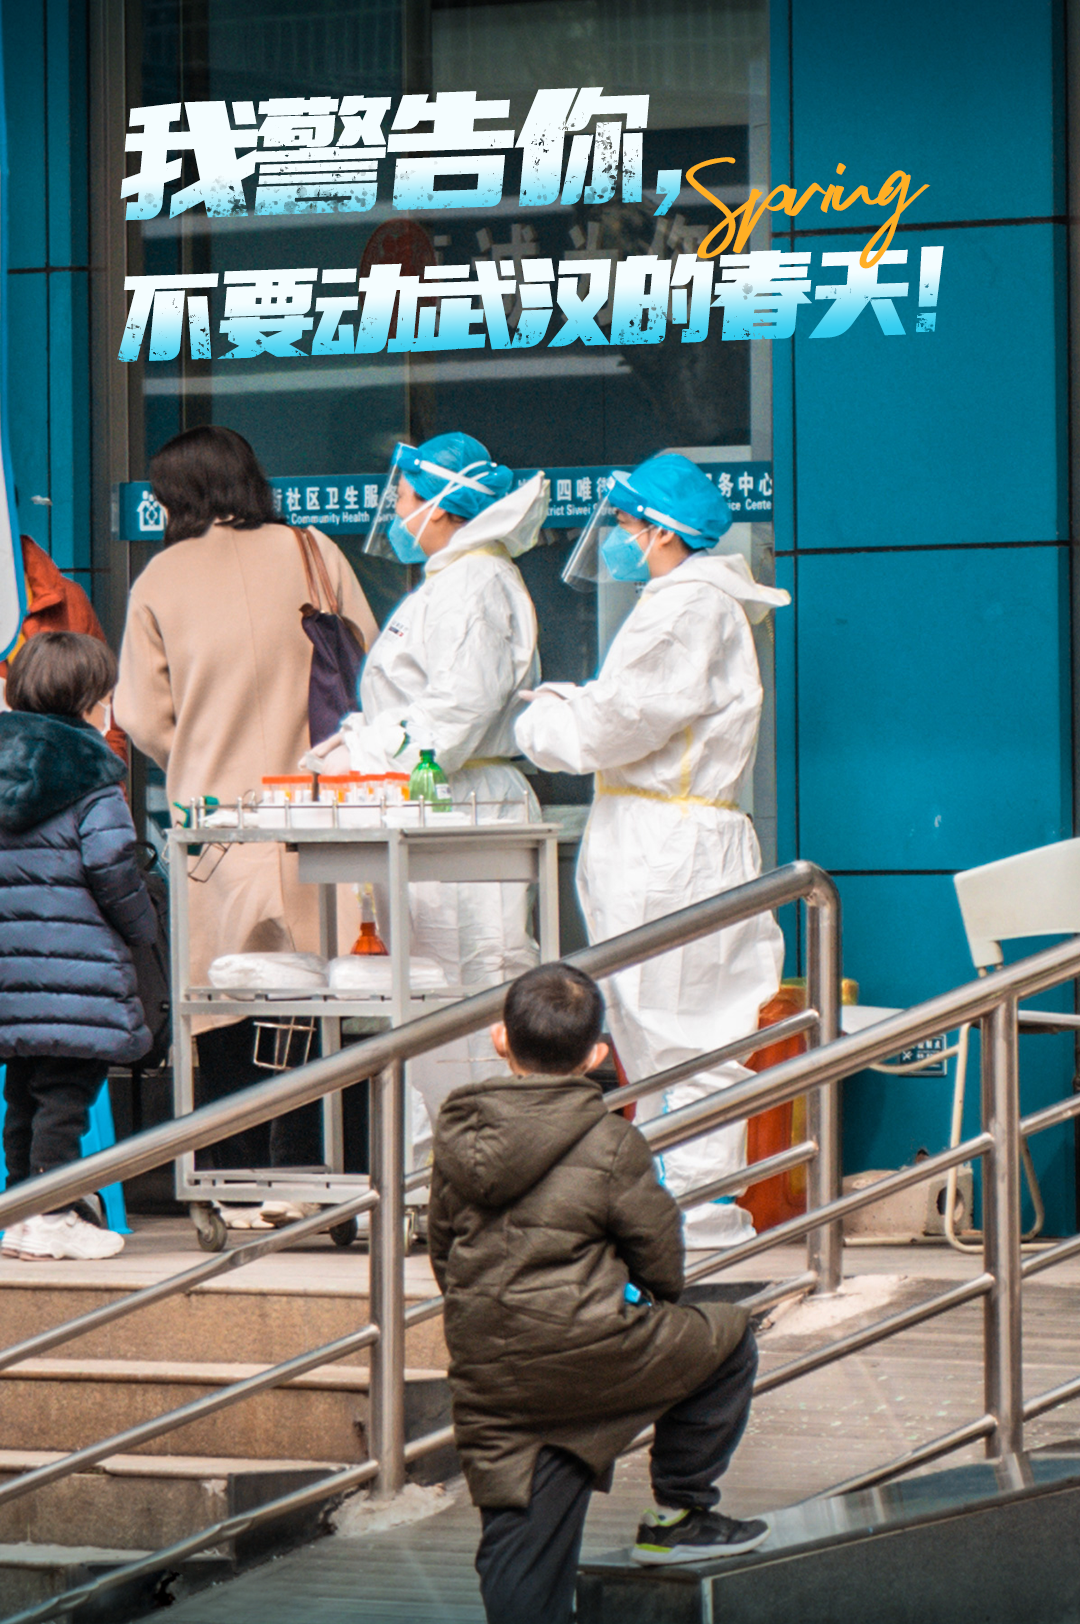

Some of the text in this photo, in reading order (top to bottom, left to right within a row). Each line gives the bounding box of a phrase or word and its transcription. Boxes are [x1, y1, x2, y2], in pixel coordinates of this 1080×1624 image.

[706, 471, 773, 497] 务中心
[566, 503, 591, 516] Siwei
[745, 498, 772, 511] Cente
[291, 513, 340, 525] Community
[342, 511, 370, 522] Health
